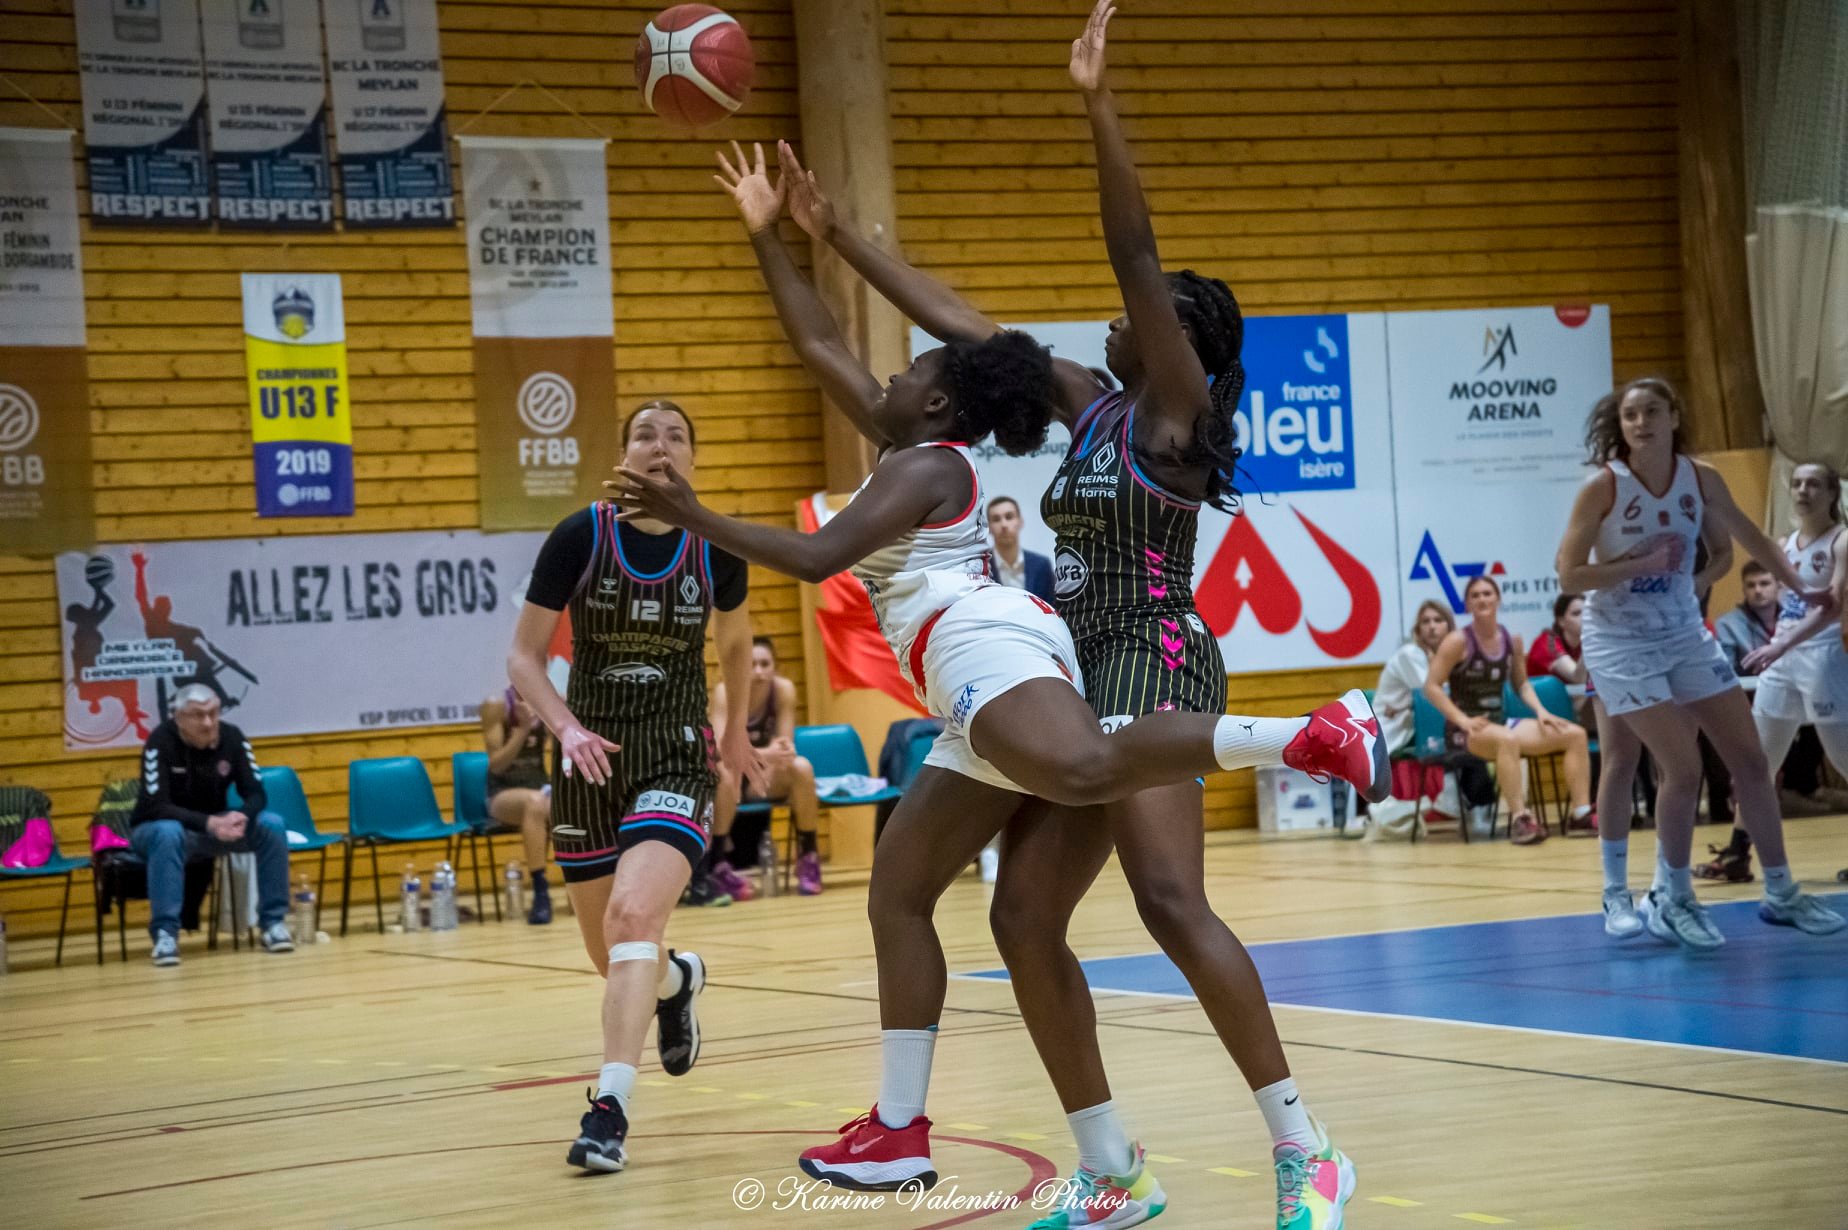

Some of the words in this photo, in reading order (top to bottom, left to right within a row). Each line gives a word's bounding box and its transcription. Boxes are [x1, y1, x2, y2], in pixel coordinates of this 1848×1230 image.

[353, 61, 369, 71] LA
[92, 193, 210, 219] RESPECT
[218, 197, 332, 222] RESPECT
[345, 196, 454, 222] RESPECT
[480, 227, 596, 246] CHAMPION
[481, 246, 509, 265] DE
[515, 247, 598, 266] FRANCE
[257, 368, 338, 380] CHAMPIONNES
[1283, 381, 1341, 401] france
[1449, 378, 1557, 400] MOOVING
[260, 385, 317, 419] U13
[325, 385, 339, 418] F
[1468, 402, 1541, 421] ARENA
[275, 448, 331, 476] 2019
[519, 437, 580, 466] FFBB
[1300, 457, 1344, 478] isère
[1051, 476, 1068, 500] 8
[1077, 475, 1119, 485] REIMS
[1623, 495, 1642, 521] 6
[227, 564, 333, 627] ALLEZ
[343, 560, 403, 621] LES
[415, 557, 498, 618] GROS
[631, 599, 661, 621] 12
[674, 605, 704, 614] REIMS
[591, 631, 689, 653] CHAMPAGNE
[608, 642, 673, 656] BASKET
[654, 795, 690, 812] JOA
